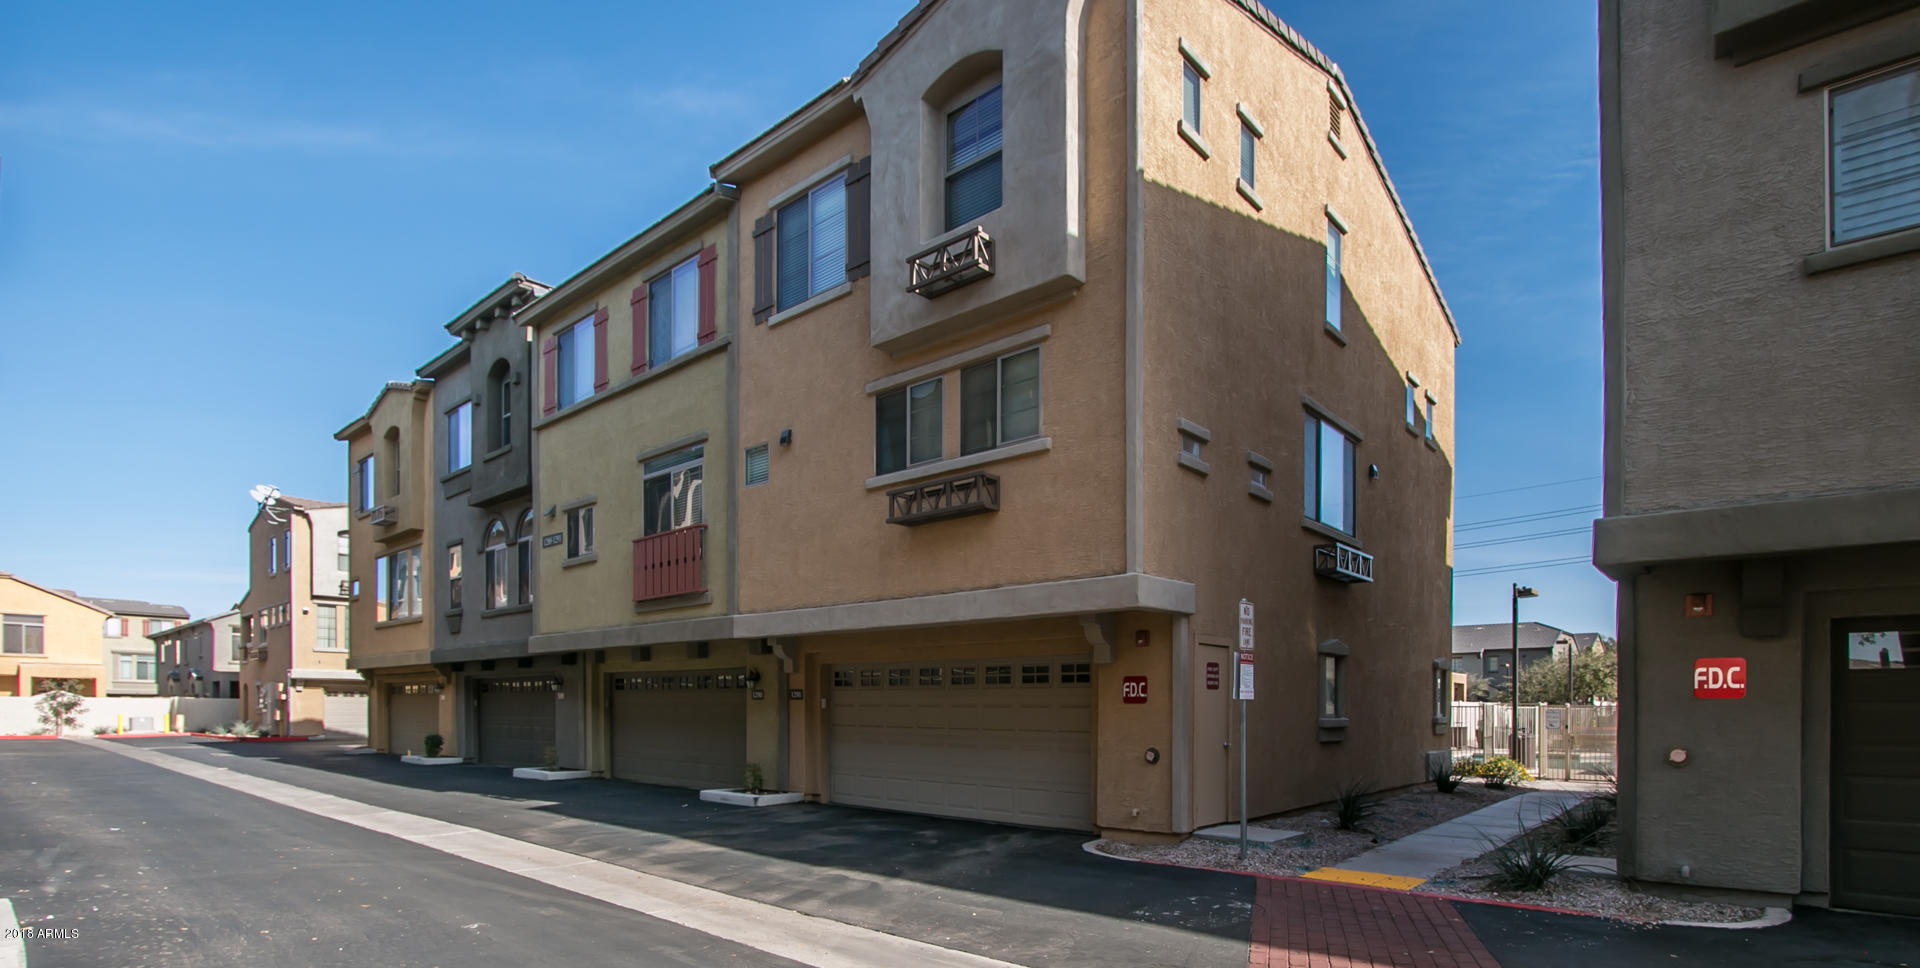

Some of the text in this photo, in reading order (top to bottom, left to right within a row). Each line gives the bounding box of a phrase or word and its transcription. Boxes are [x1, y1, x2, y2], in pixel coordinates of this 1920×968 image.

[1242, 626, 1252, 638] FIRE
[1694, 666, 1745, 689] F.D.C.
[1123, 682, 1147, 697] F.D.C.
